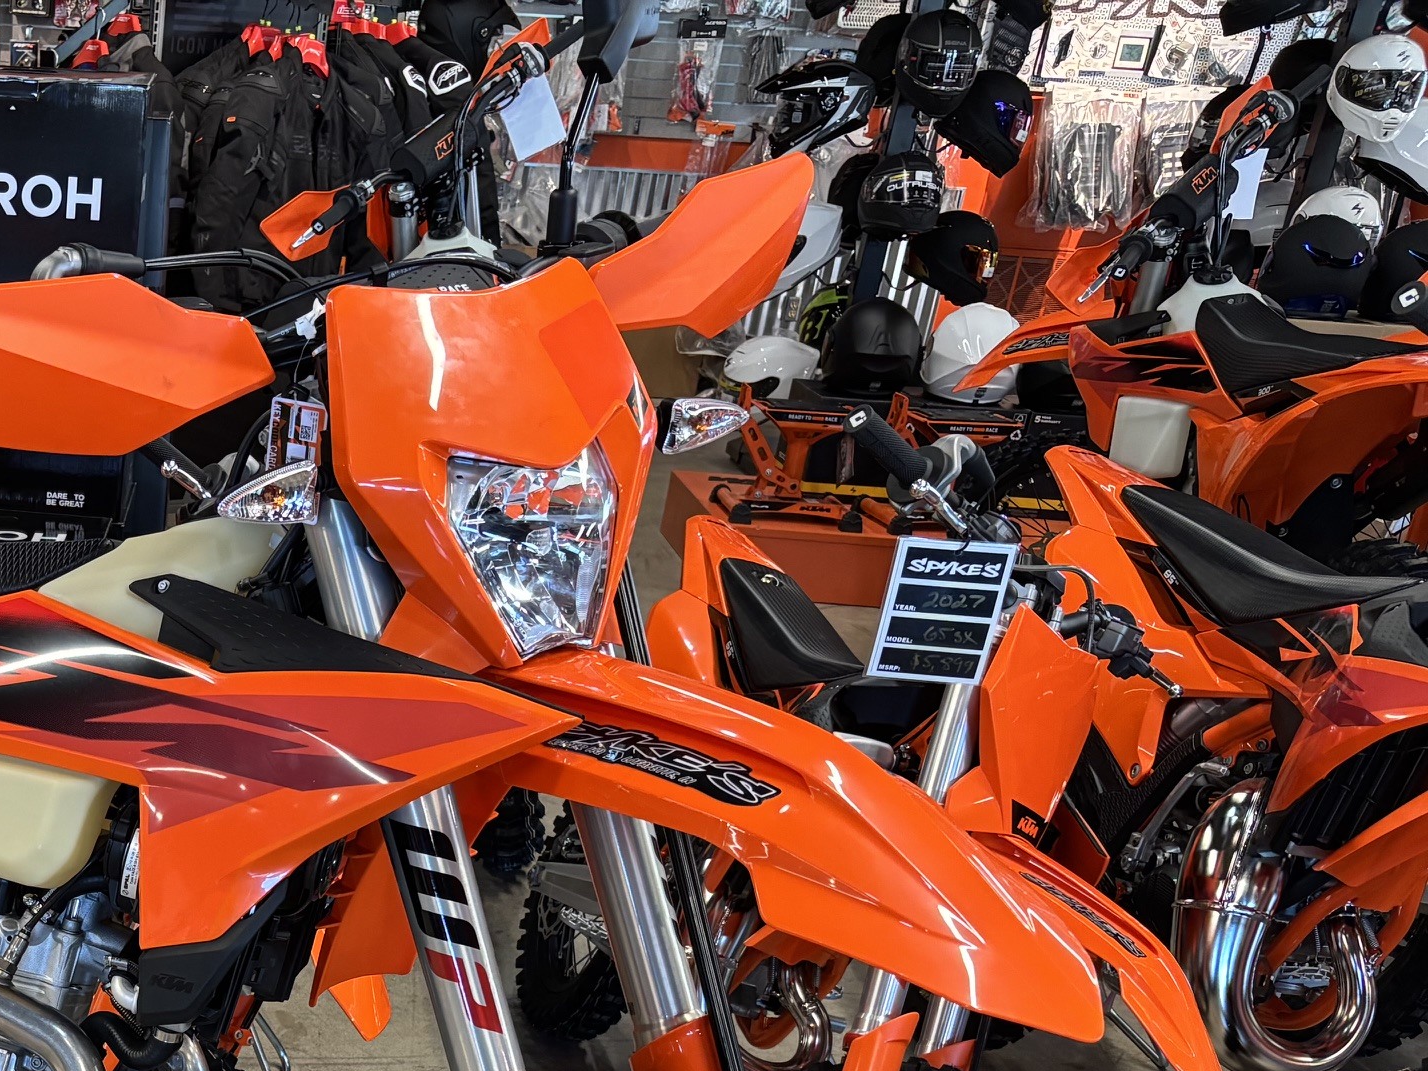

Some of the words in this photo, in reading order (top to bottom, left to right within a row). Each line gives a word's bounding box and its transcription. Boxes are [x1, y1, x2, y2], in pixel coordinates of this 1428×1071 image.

[434, 131, 455, 160] KT
[1191, 166, 1220, 195] KTM
[46, 491, 68, 501] DARE
[73, 494, 85, 502] TO
[58, 500, 84, 508] GREAT
[907, 557, 1002, 578] SPYKE'S
[894, 602, 917, 612] YEAR:
[885, 635, 914, 645] MODEL:
[877, 663, 902, 672] MSRP:
[1016, 815, 1039, 838] KTM
